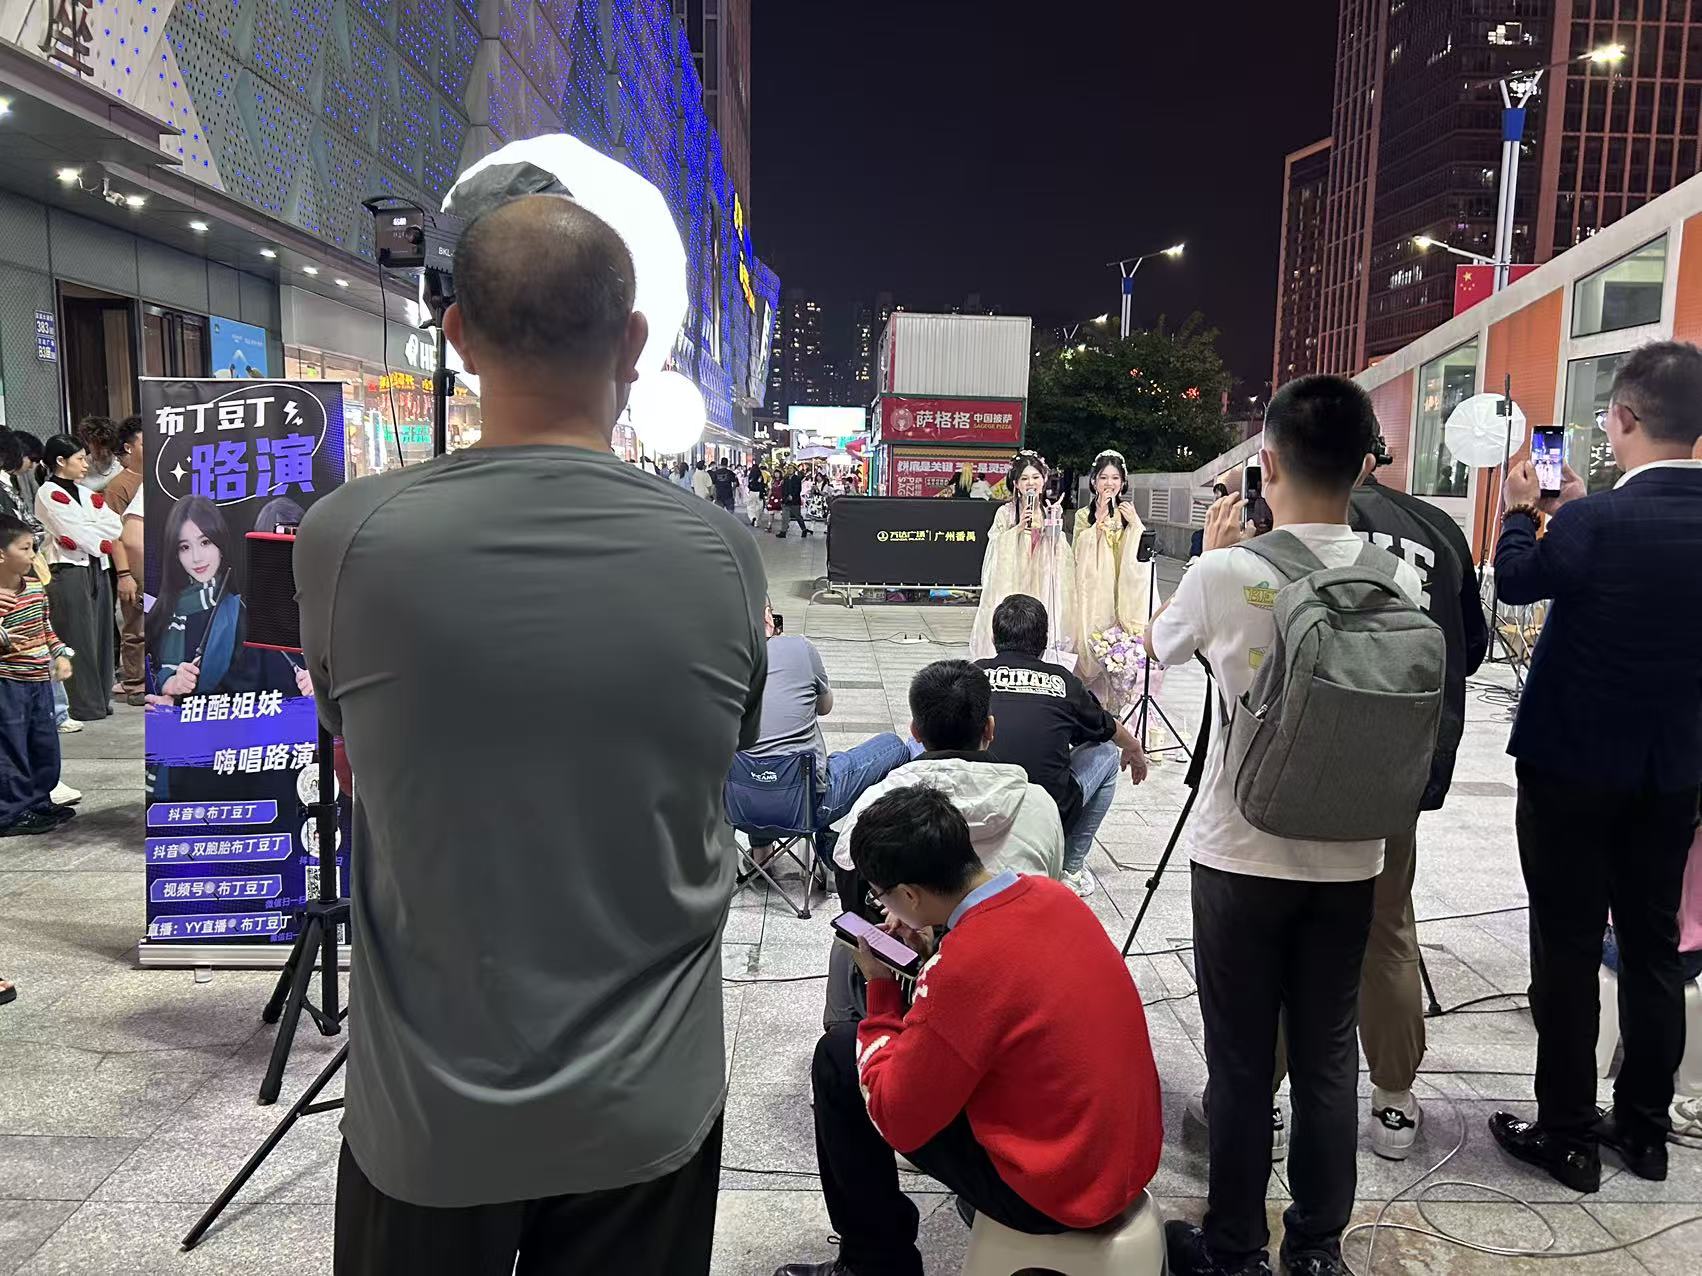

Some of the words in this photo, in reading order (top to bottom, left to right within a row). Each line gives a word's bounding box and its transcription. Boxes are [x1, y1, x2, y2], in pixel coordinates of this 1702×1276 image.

[155, 397, 275, 436] 布丁豆丁
[916, 410, 970, 429] 萨格格
[973, 413, 1012, 424] 中国披萨
[191, 433, 315, 499] 路演
[890, 530, 926, 539] 万达广场
[934, 531, 976, 542] 广州番禺
[180, 689, 283, 723] 甜酷姐妹
[213, 742, 316, 776] 嗨唱路演
[168, 807, 194, 821] 抖音
[206, 805, 257, 819] 布丁豆丁
[153, 844, 179, 859] 抖音
[192, 837, 285, 856] 双胞胎布丁豆丁
[163, 881, 204, 897] 视频号
[217, 880, 273, 895] 布丁豆丁
[240, 915, 292, 931] 布丁豆丁
